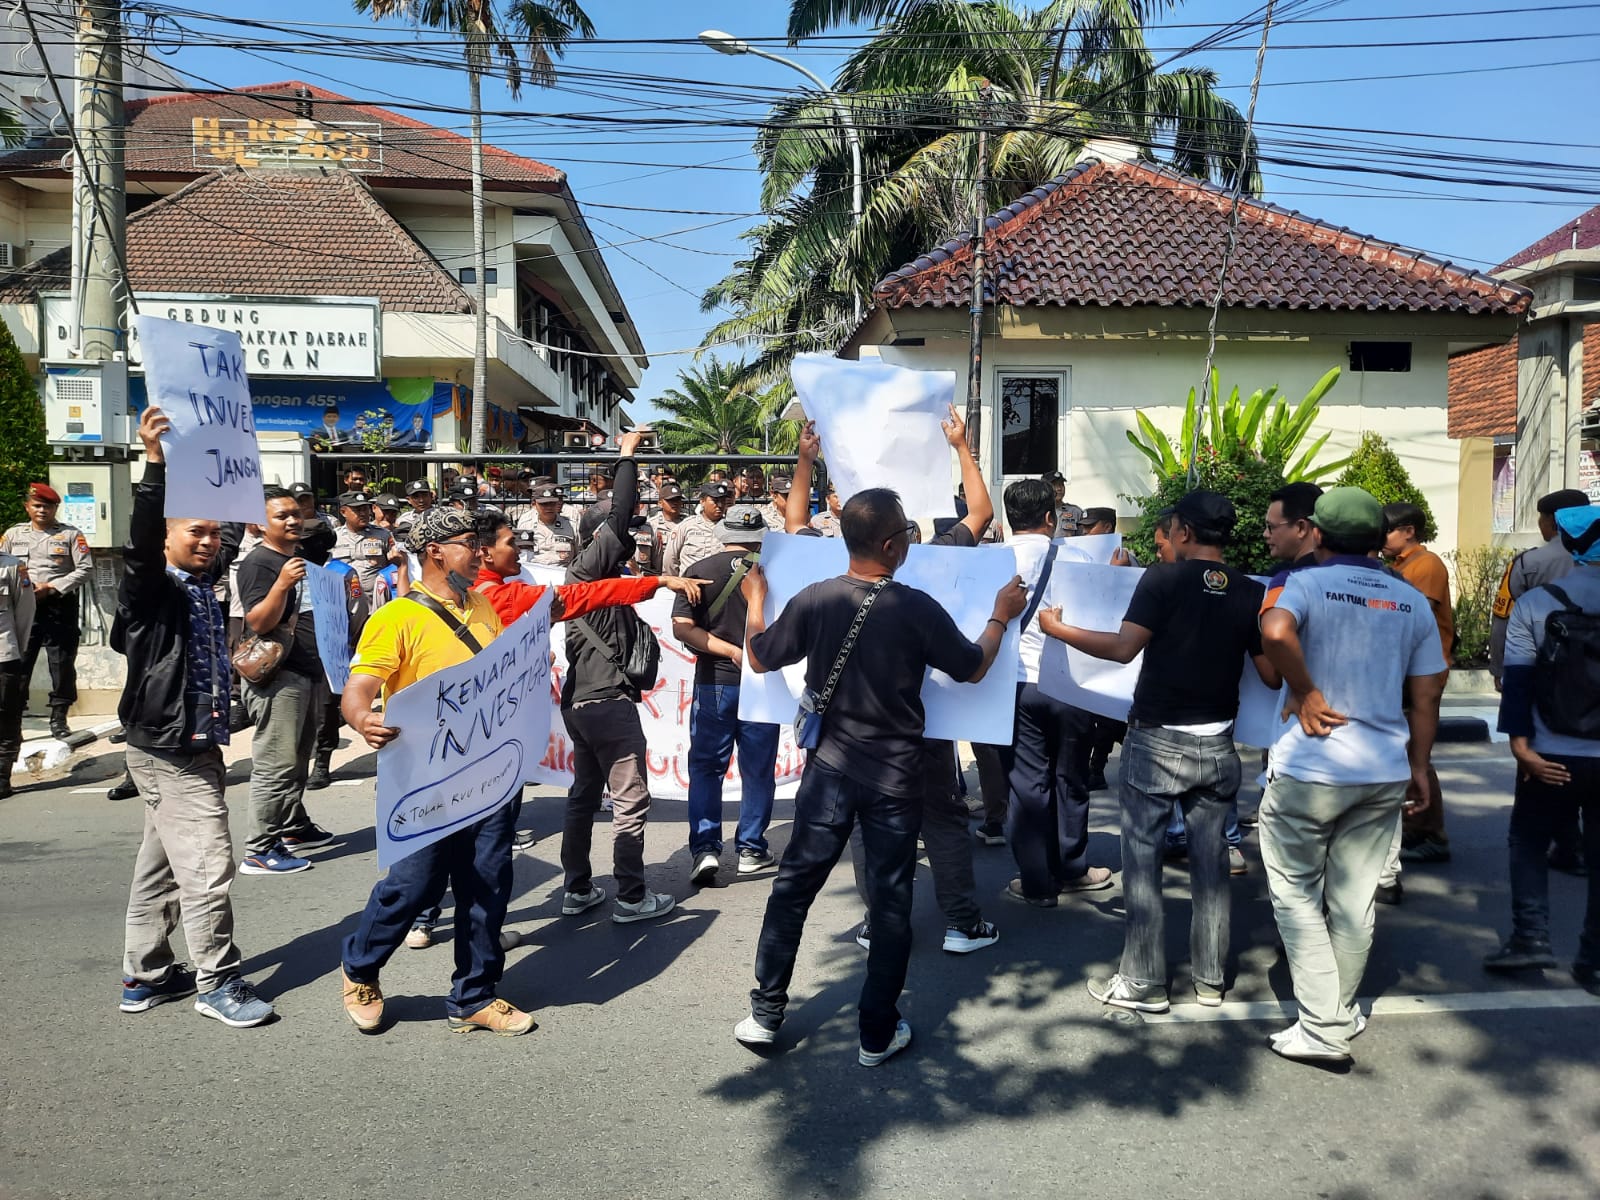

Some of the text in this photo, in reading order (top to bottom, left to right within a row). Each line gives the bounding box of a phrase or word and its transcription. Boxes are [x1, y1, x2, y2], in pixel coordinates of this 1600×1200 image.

[167, 307, 259, 325] GEDUNG
[305, 331, 367, 347] DAERAH
[1326, 591, 1412, 613] FAKTUALNEWS.CO
[436, 647, 516, 721] KENAPA
